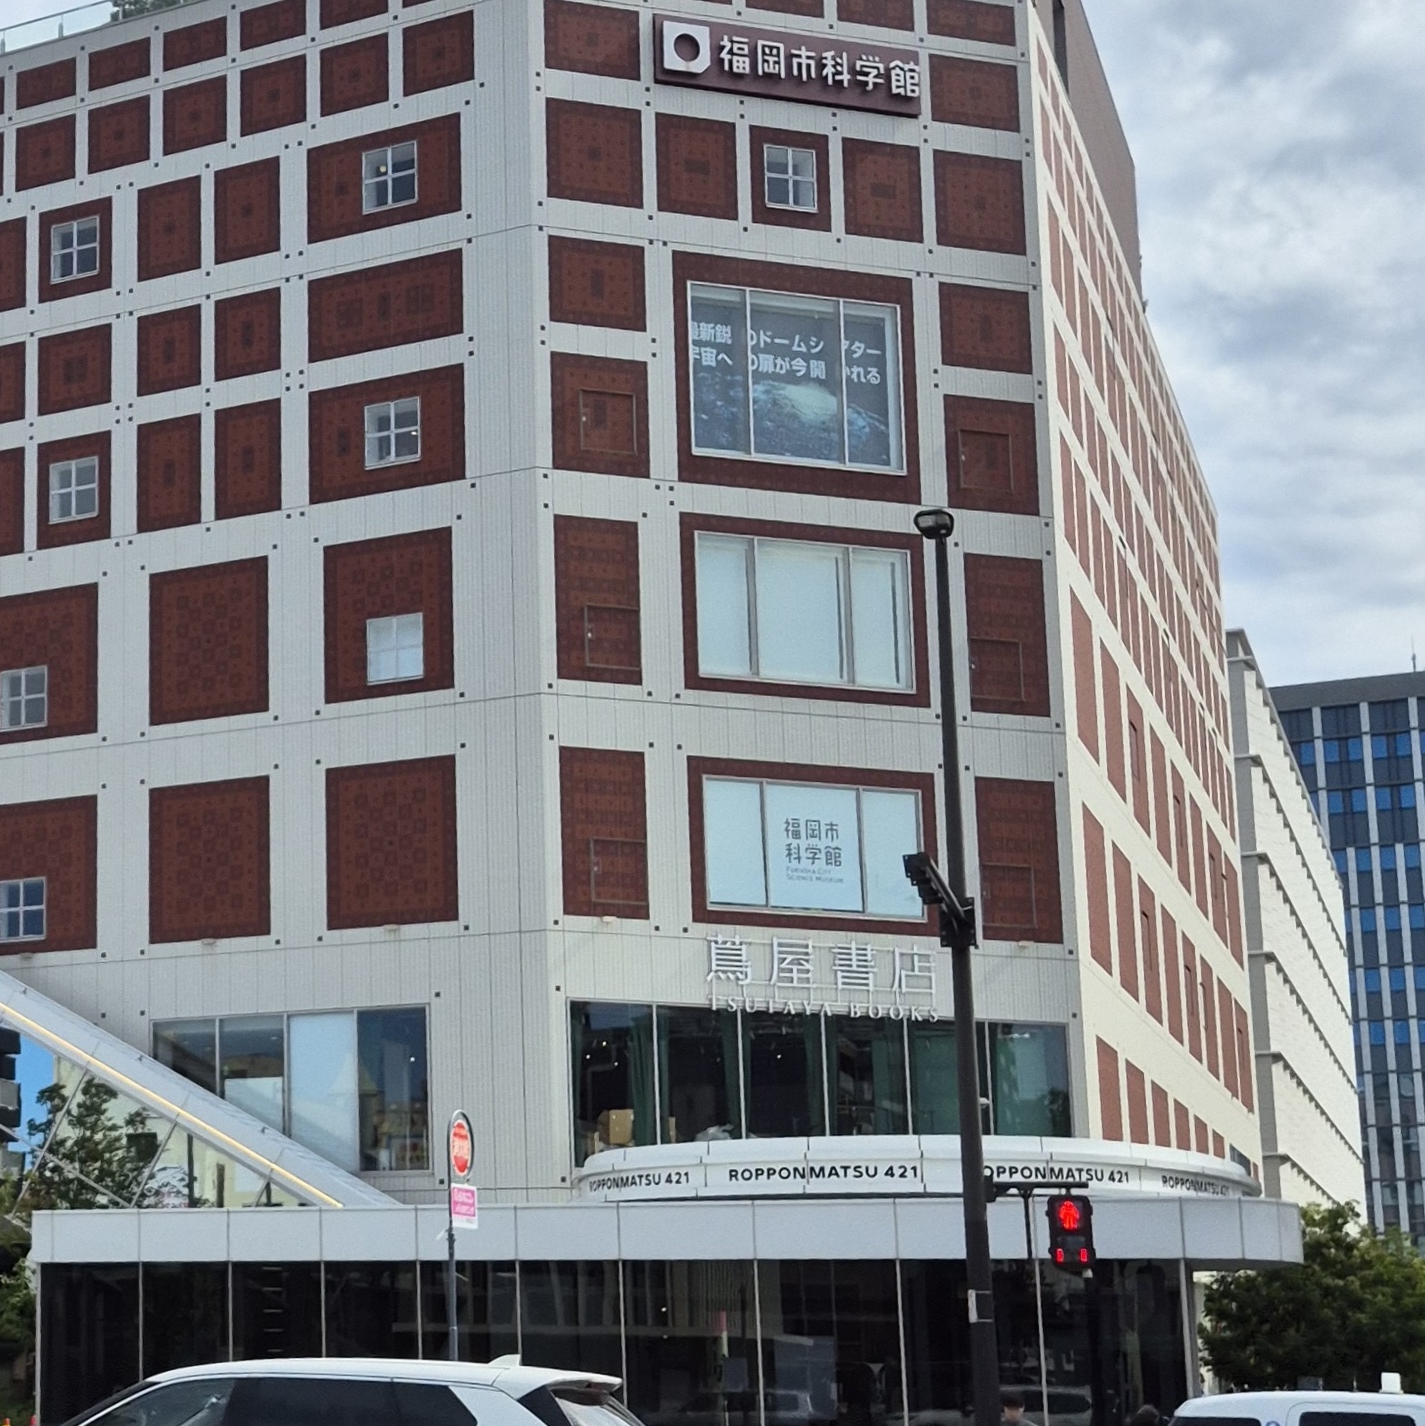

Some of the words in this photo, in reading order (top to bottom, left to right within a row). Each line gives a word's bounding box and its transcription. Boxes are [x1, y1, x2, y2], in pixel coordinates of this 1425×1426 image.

[719, 34, 920, 98] 福岡市科学館
[784, 817, 840, 842] 福岡市
[784, 842, 843, 867] 科学館
[706, 934, 936, 993] 蔦屋書店
[707, 995, 833, 1016] TSUTAYA
[849, 1002, 939, 1022] BOOKS
[664, 1171, 690, 1185] 421
[728, 1164, 879, 1182] ROPPONMATSU
[883, 1164, 919, 1180] 421
[983, 1165, 1104, 1182] OPPONMATSU
[1108, 1169, 1130, 1183] 421
